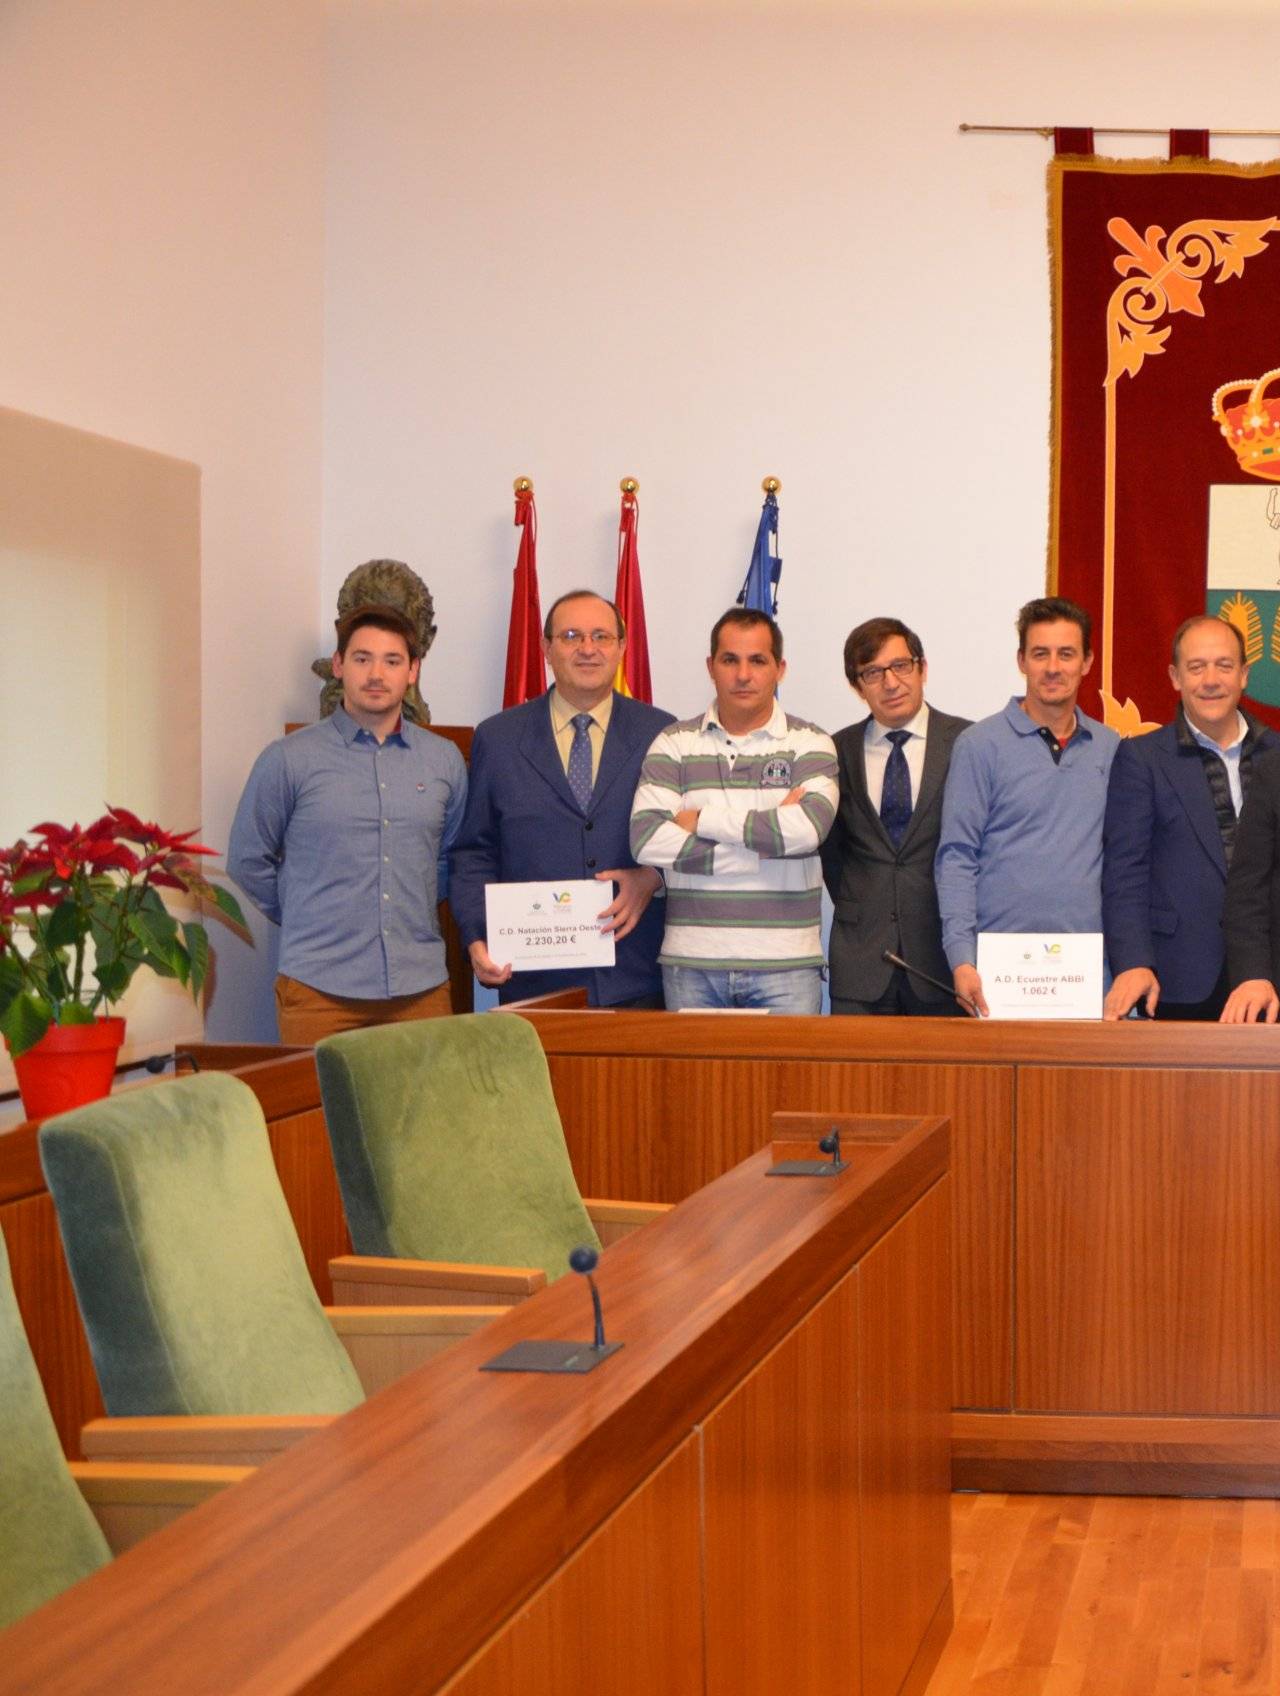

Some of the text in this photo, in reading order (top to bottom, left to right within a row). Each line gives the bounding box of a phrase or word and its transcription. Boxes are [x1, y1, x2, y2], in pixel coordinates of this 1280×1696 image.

[499, 923, 602, 936] C.D. Natación Sierra Oeste
[525, 935, 577, 946] 2.230,20 €
[994, 975, 1014, 983] A.D.
[1017, 975, 1058, 983] Ecuestre
[1022, 987, 1057, 995] 1.062 €
